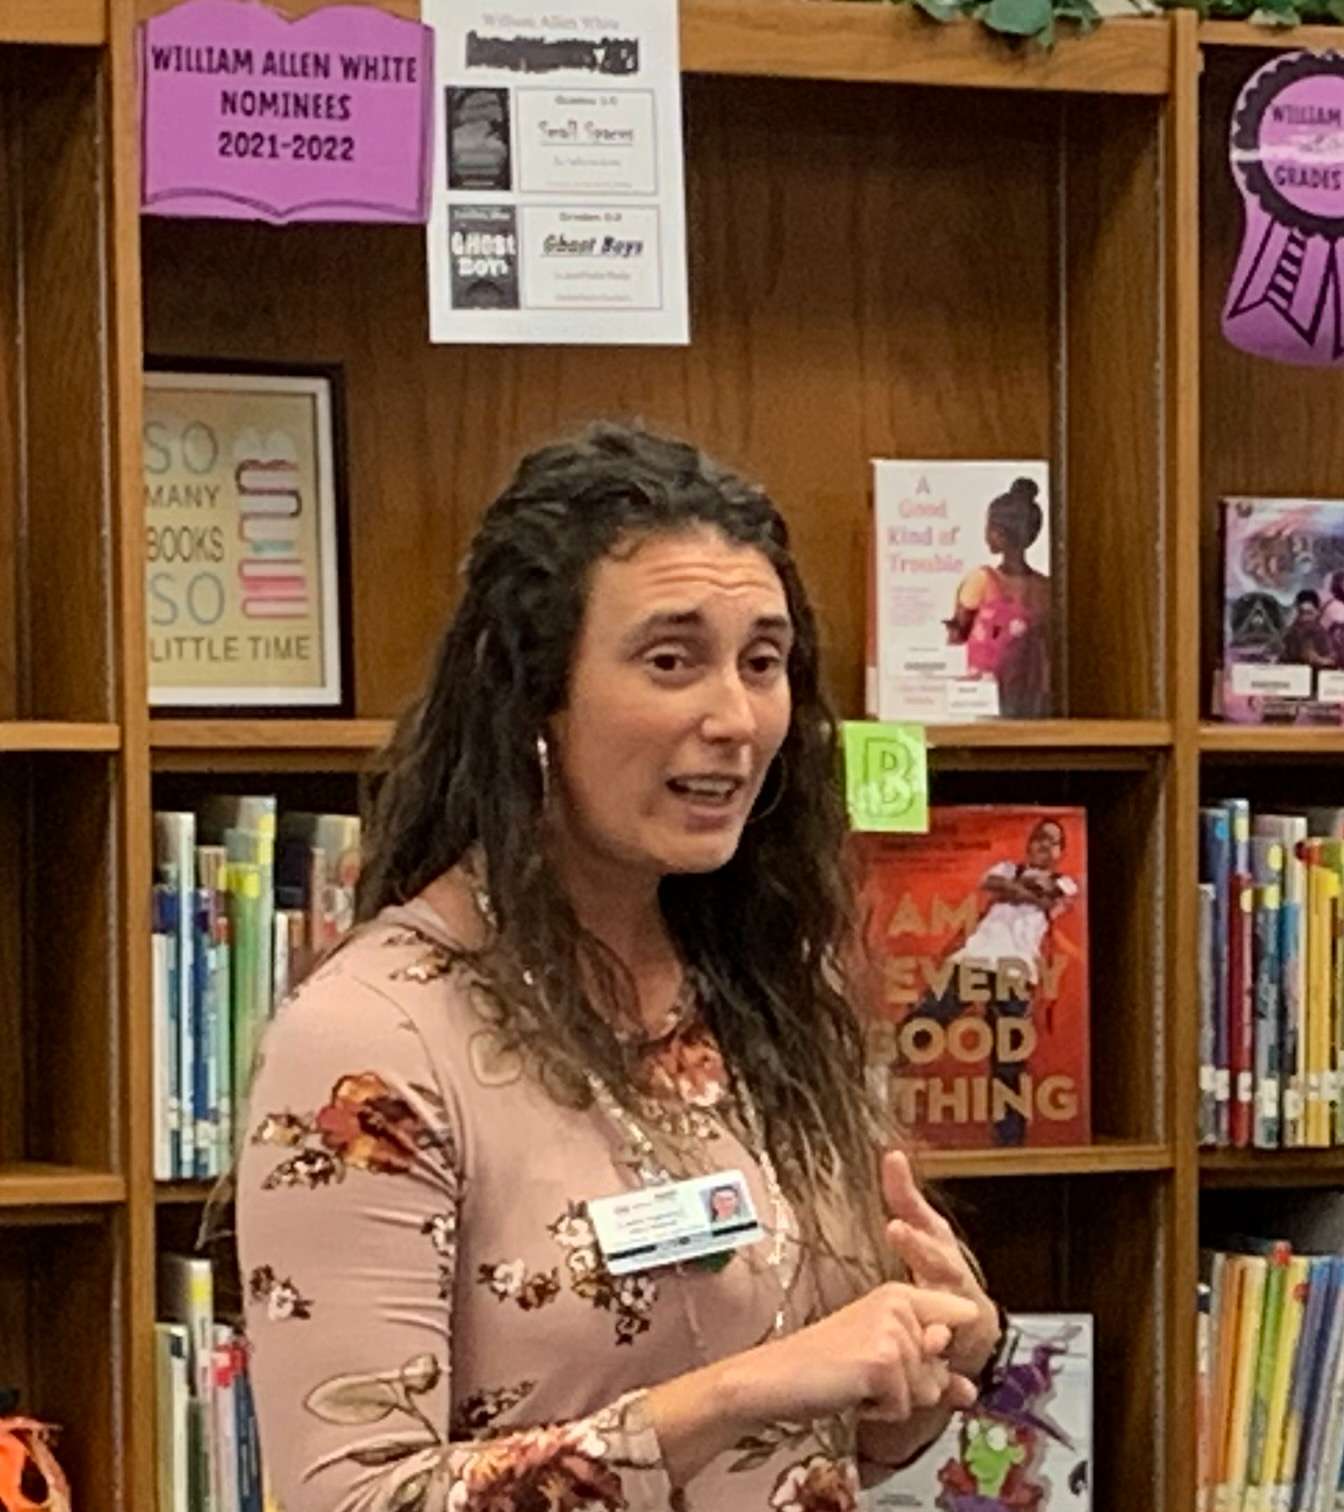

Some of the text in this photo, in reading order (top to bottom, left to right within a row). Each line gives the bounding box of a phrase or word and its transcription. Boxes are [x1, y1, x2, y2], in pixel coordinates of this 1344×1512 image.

[151, 45, 417, 83] WILLIAM ALLEN WHITE
[220, 90, 352, 121] NOMINEES
[217, 131, 356, 162] 2021-2022
[143, 419, 220, 476] SO
[143, 483, 222, 509] MANY
[145, 525, 226, 564] BOOKS
[148, 571, 226, 627] SO
[149, 634, 313, 664] LITTLE TIME
[861, 736, 915, 820] B
[887, 891, 980, 938] AM
[883, 951, 1071, 1005] EVERY
[891, 1073, 1080, 1126] THING
